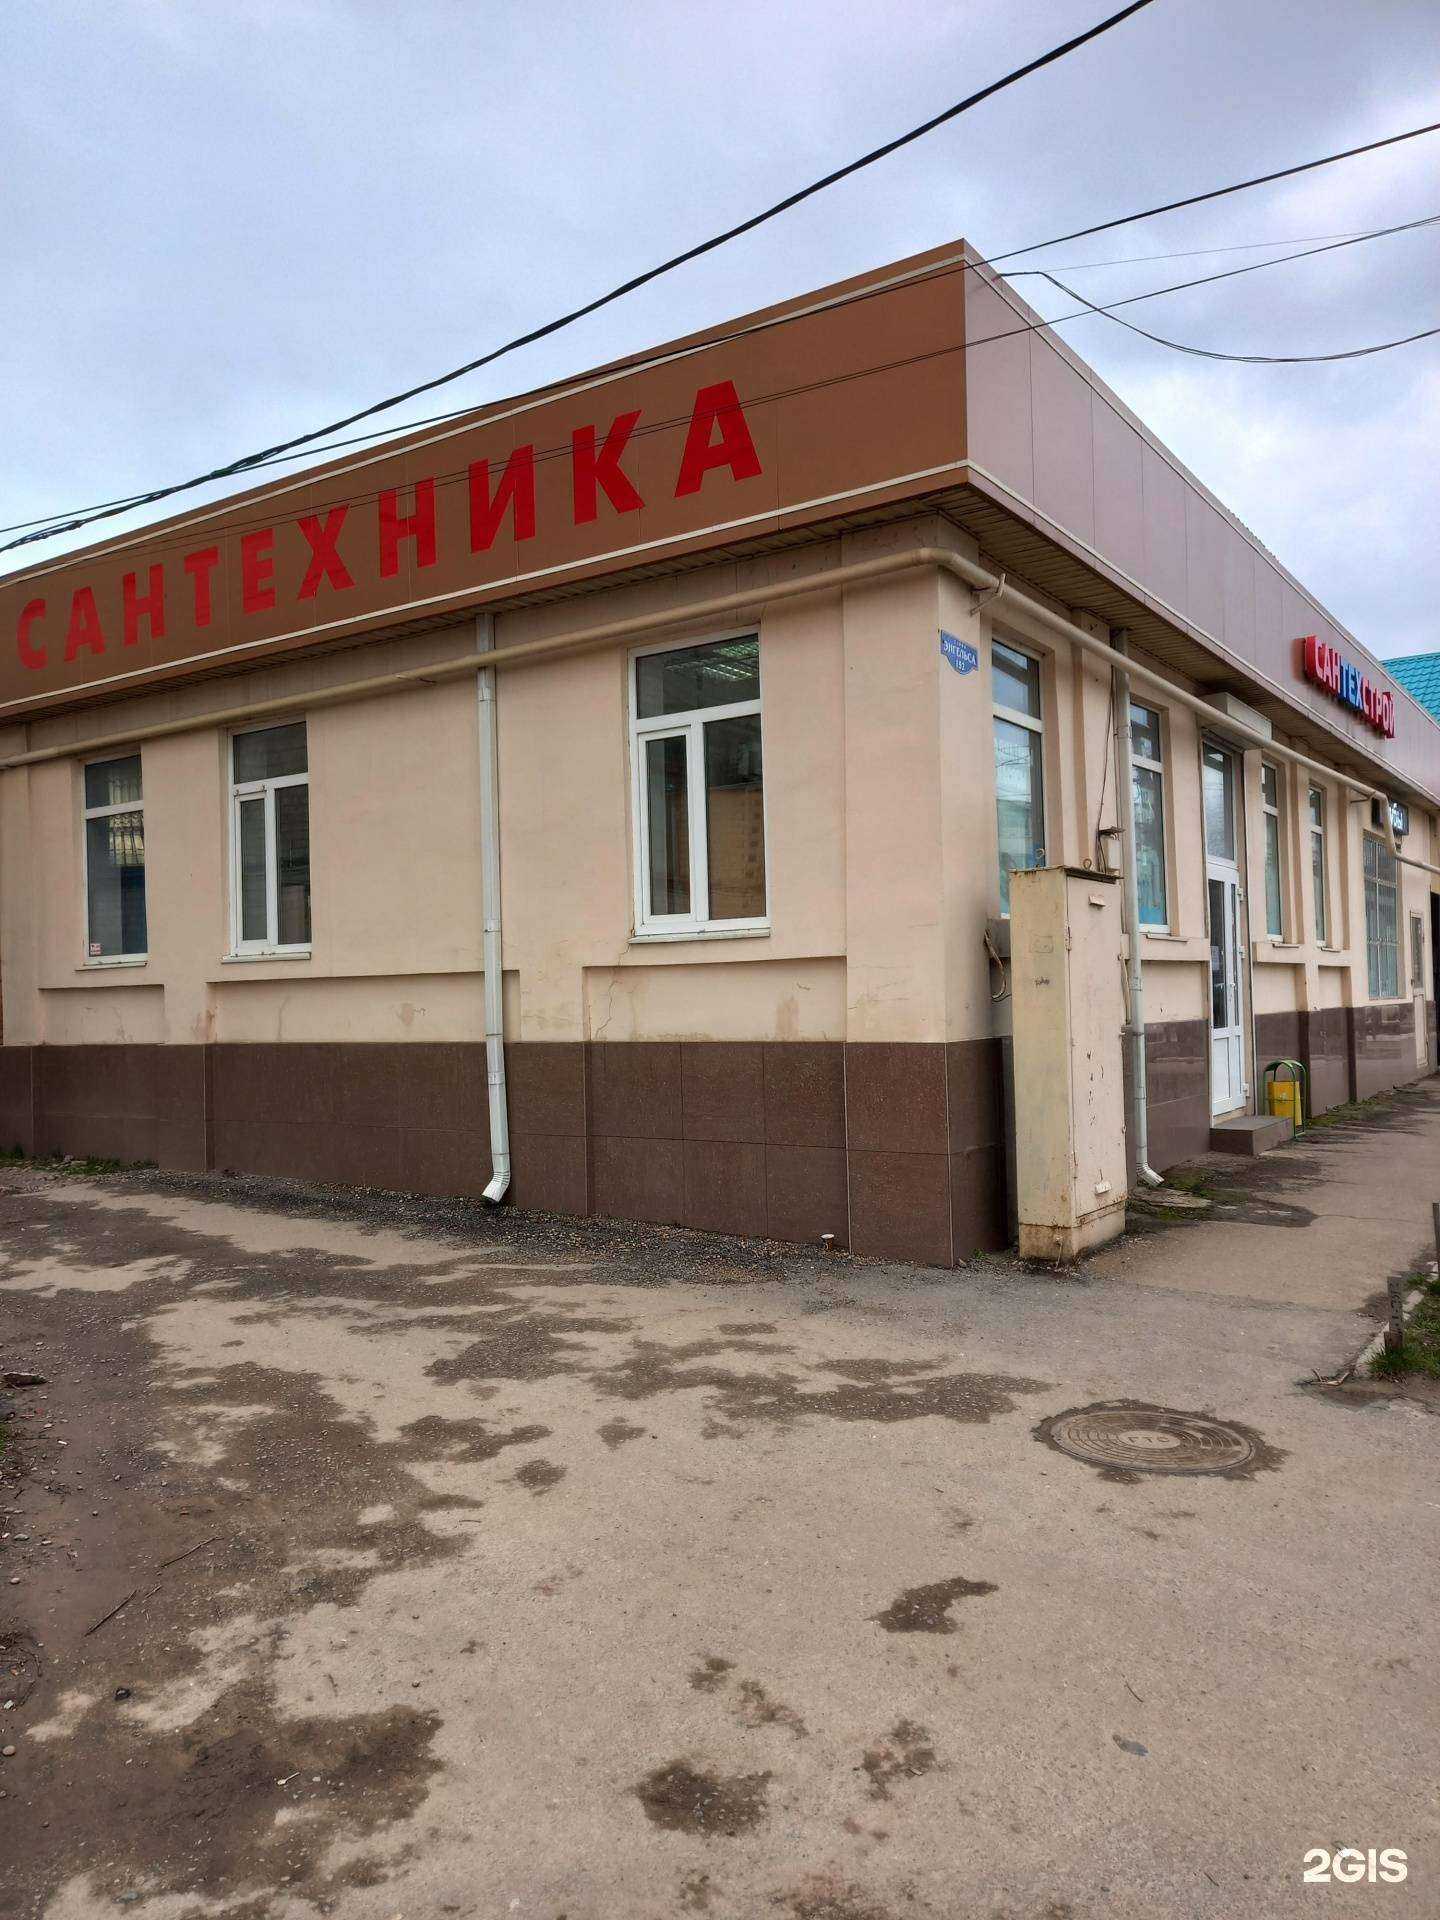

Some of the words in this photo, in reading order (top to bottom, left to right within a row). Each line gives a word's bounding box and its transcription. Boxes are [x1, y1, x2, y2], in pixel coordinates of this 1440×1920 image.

[16, 380, 763, 669] САНТЕХНИКА
[943, 640, 977, 666] ЭНГЕЛЬСА
[1305, 635, 1395, 738] САНТЕХСТРОЙ
